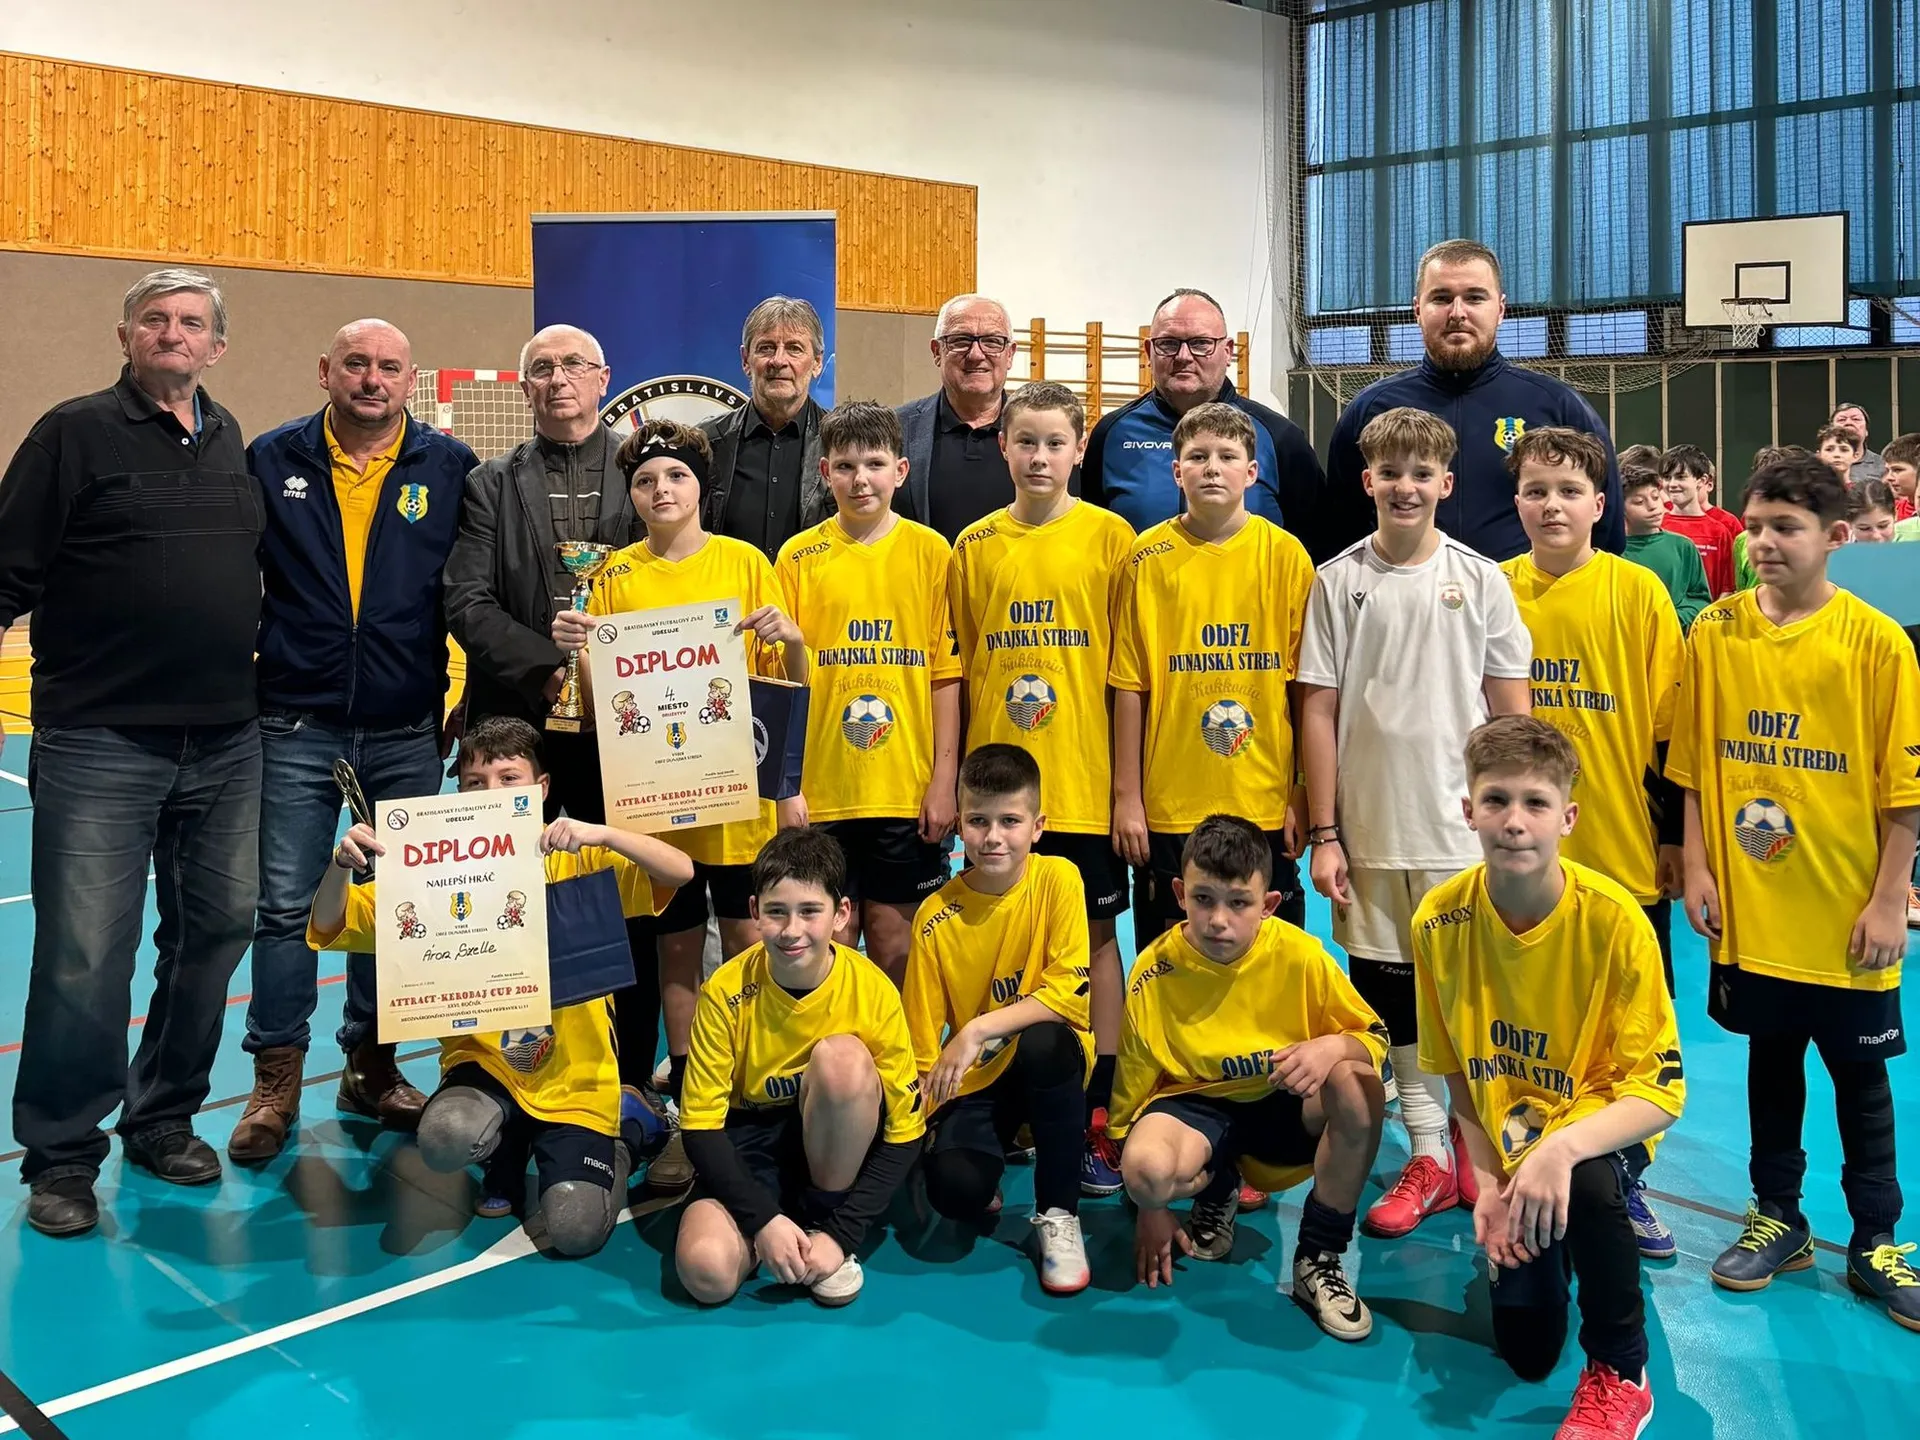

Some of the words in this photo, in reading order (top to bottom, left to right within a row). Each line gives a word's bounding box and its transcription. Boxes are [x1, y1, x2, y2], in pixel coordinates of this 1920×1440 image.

[605, 382, 737, 424] BRATISLAVS
[1123, 441, 1173, 450] GIVOVA
[283, 488, 307, 500] errea
[792, 539, 832, 563] SPROX
[958, 526, 996, 552] SPROX
[1132, 540, 1174, 567] SPROX
[1009, 599, 1054, 624] ObFZ
[848, 619, 893, 642] ObFZ
[986, 626, 1039, 652] DNAJSKÁ
[1043, 629, 1090, 648] STREDA
[1201, 623, 1250, 648] ObFZ
[615, 643, 720, 678] DIPLOM
[818, 643, 876, 668] DUNAJSKÁ
[881, 646, 926, 667] STREDA
[1168, 649, 1234, 674] DUNAJSKÁ
[1531, 657, 1581, 683] ObFZ
[665, 685, 676, 702] 4.
[1531, 685, 1566, 708] JSKÁ
[657, 702, 689, 712] MIESTO
[1748, 709, 1801, 741] ObFZ
[1720, 739, 1777, 766] UNAJSKÁ
[1783, 746, 1849, 773] STREDA
[705, 785, 725, 796] CUP
[728, 782, 748, 793] 2026
[403, 833, 516, 868] DIPLOM
[426, 874, 467, 888] NAJLEPŠÍ
[468, 871, 496, 884] HRÁČ
[922, 899, 963, 938] SPROX
[454, 940, 497, 961] Szelle
[1131, 958, 1174, 996] SPROX
[490, 986, 513, 997] CUP
[515, 984, 539, 995] 2026
[728, 981, 760, 1008] SPOX
[1490, 1019, 1548, 1060] ObFZ
[1532, 1065, 1574, 1100] STRA
